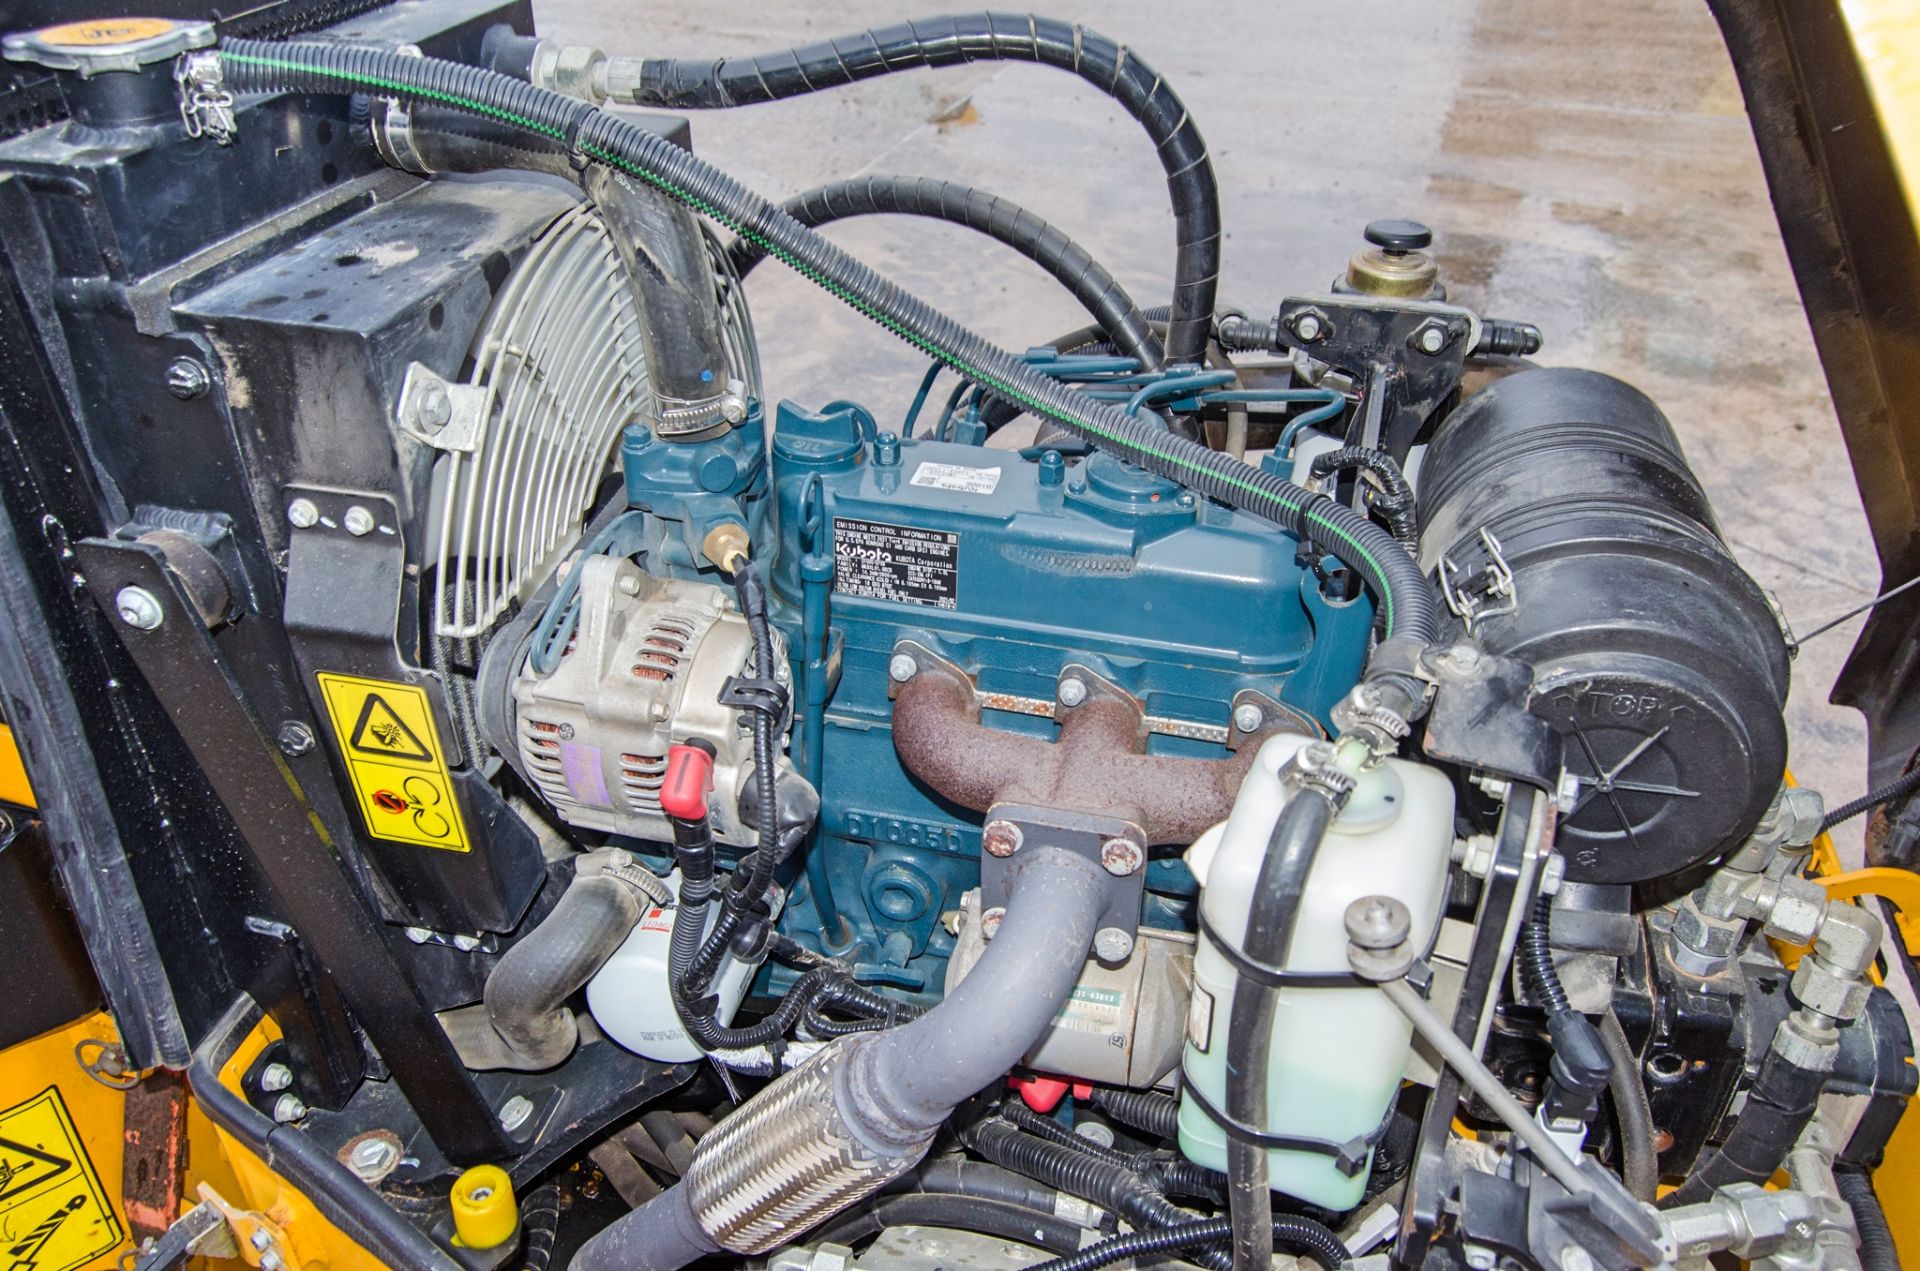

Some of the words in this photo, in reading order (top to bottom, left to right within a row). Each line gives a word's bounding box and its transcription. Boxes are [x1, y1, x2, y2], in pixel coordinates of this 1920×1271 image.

[836, 521, 867, 532] EMISSION
[870, 525, 896, 536] CONTROL
[901, 529, 942, 542] INFORMATION
[836, 542, 892, 562] Kubota
[896, 555, 915, 564] KUBOTA
[917, 558, 952, 570] Corporation
[1588, 691, 1661, 719] TOP
[1111, 1035, 1124, 1049] 57
